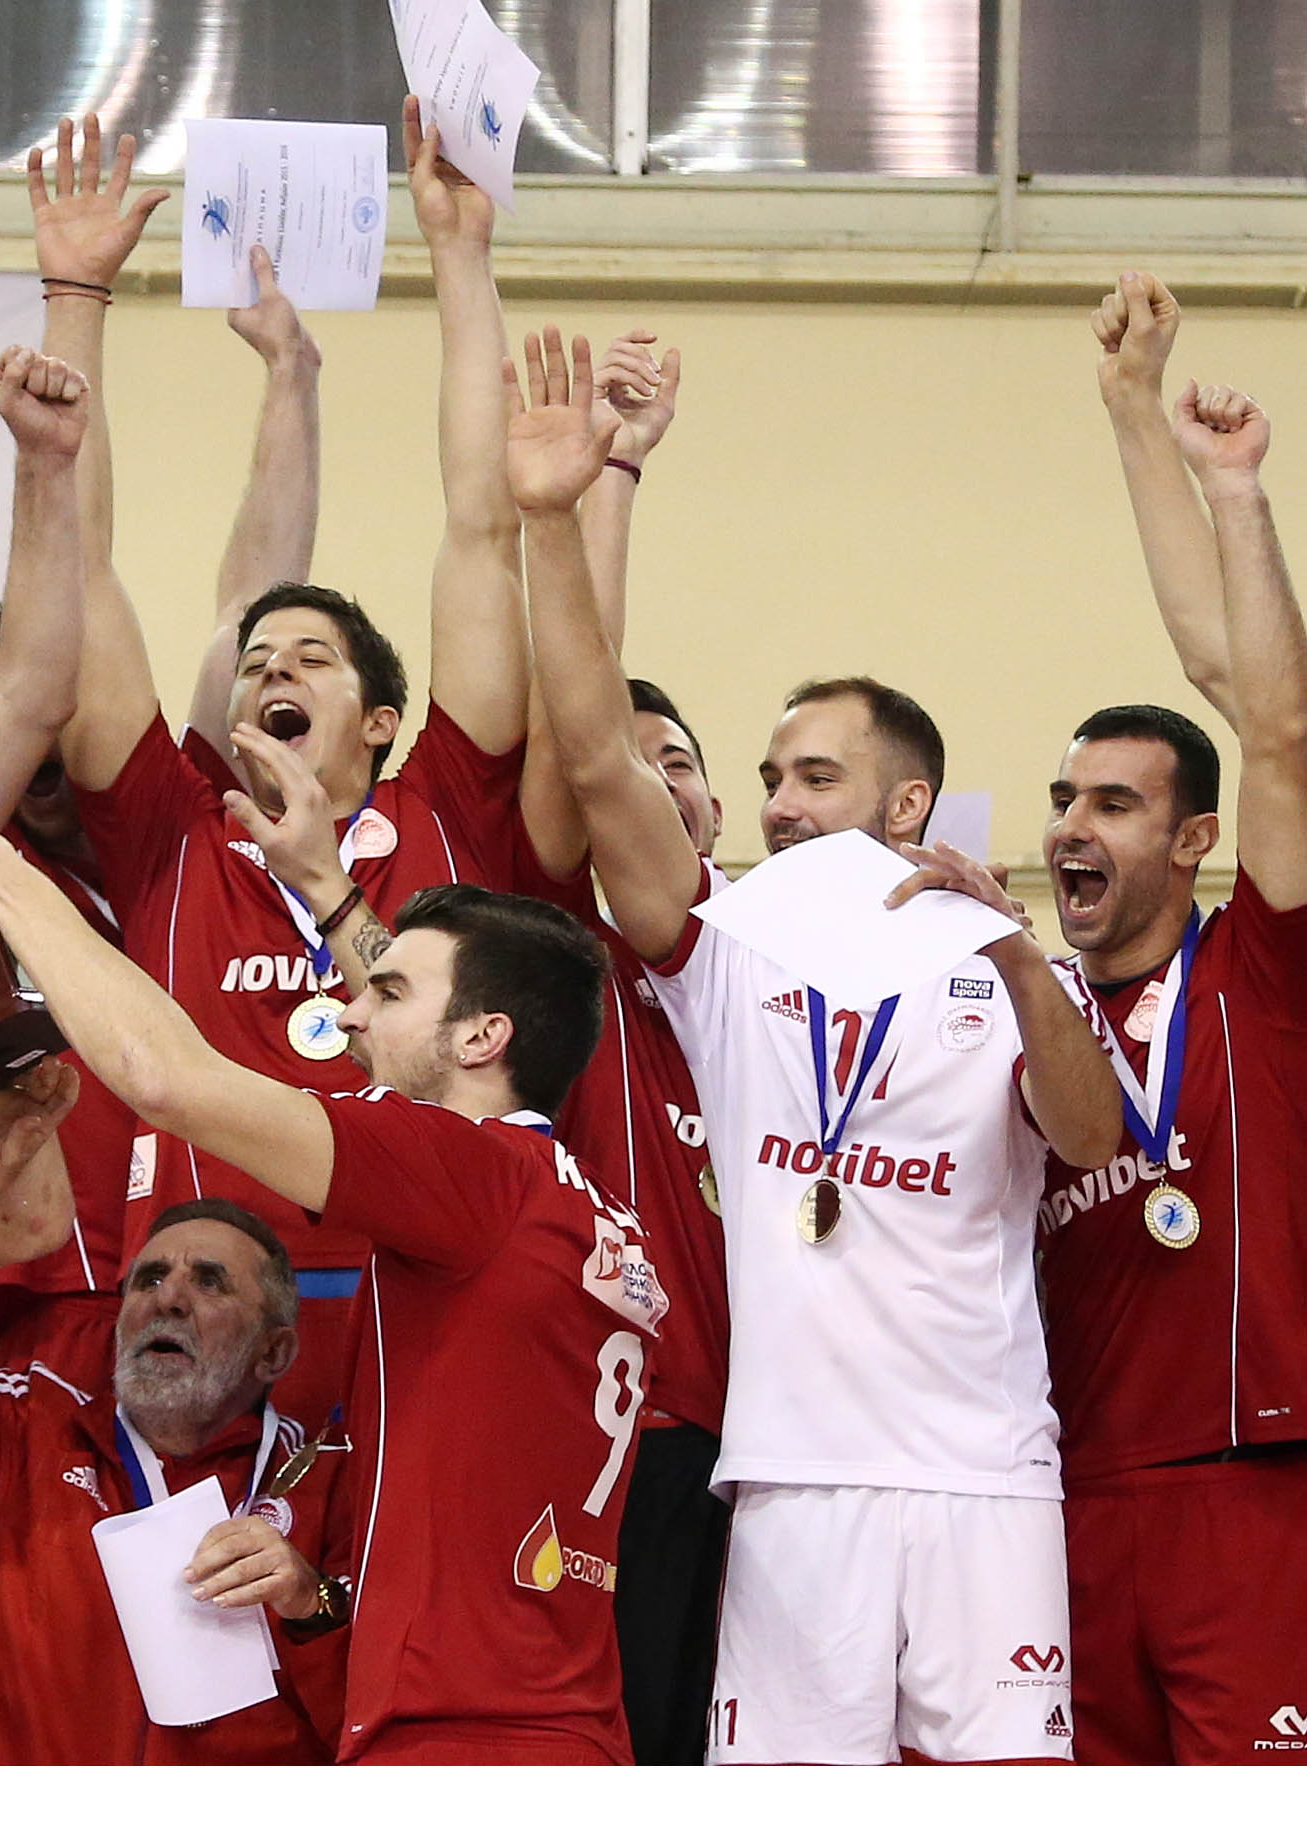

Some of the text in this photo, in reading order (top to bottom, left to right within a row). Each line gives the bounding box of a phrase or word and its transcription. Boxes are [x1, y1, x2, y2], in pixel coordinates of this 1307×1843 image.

[952, 987, 990, 999] sports
[953, 978, 991, 991] nova
[761, 1000, 808, 1025] adidas
[582, 1331, 644, 1517] 9
